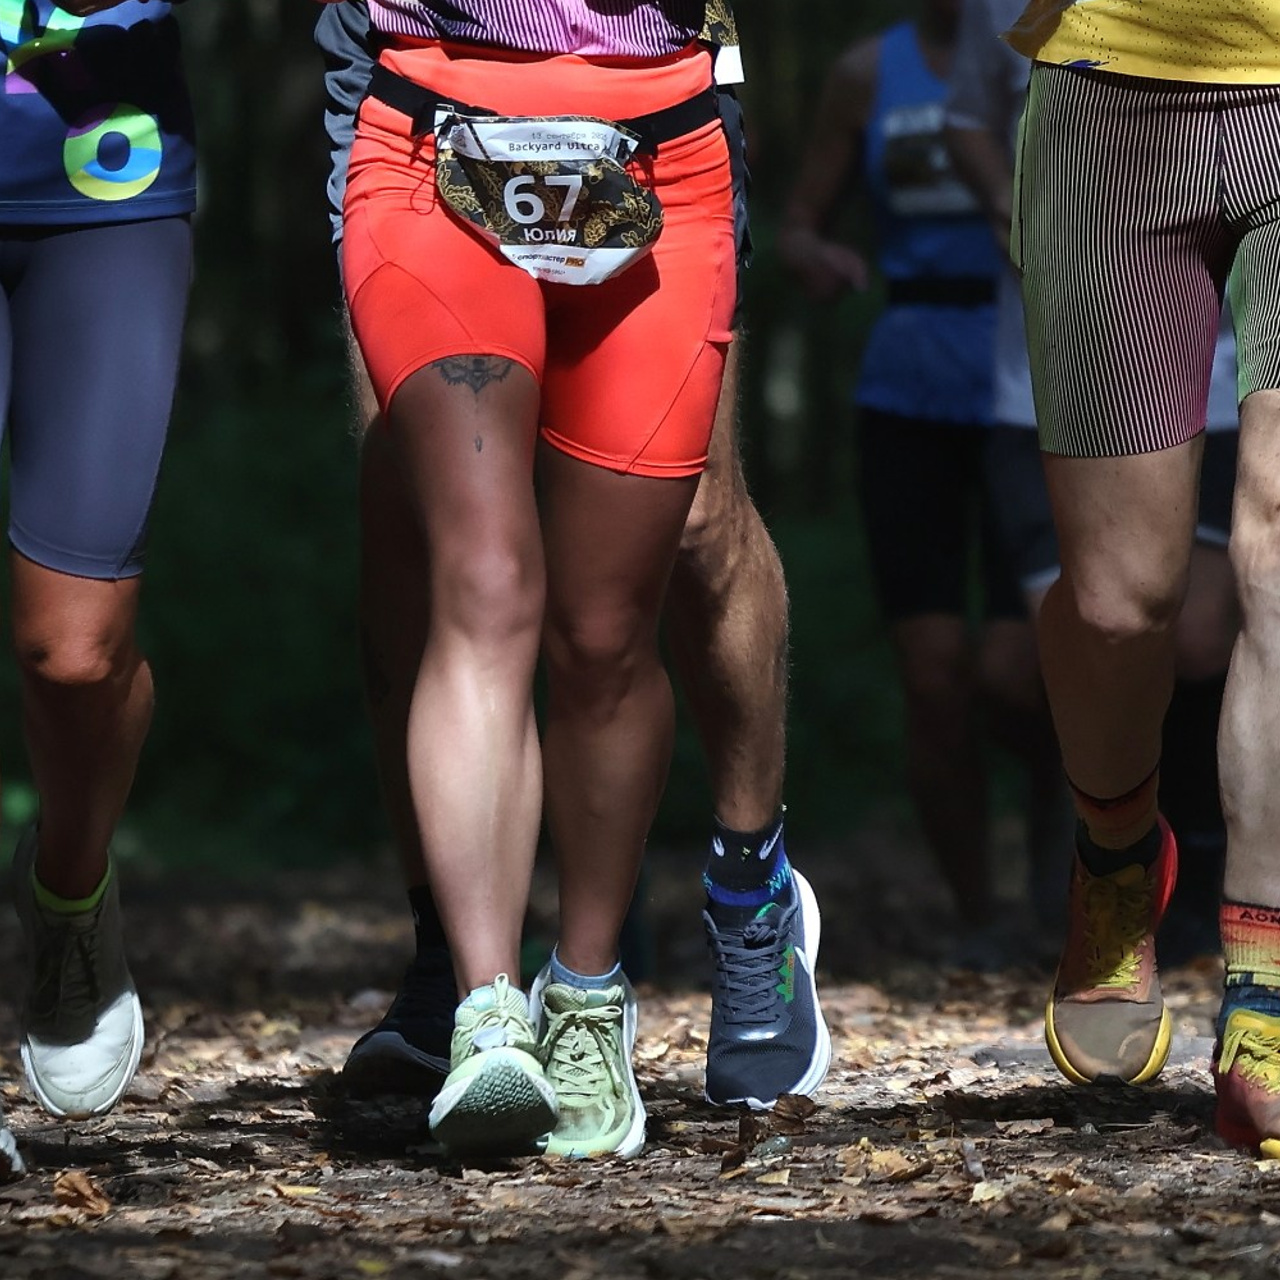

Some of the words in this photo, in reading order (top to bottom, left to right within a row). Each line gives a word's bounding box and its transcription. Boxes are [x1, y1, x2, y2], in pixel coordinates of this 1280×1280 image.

[508, 142, 561, 153] Backyard
[567, 142, 600, 151] Ultra
[503, 174, 583, 224] 67
[523, 227, 577, 242] Юлия
